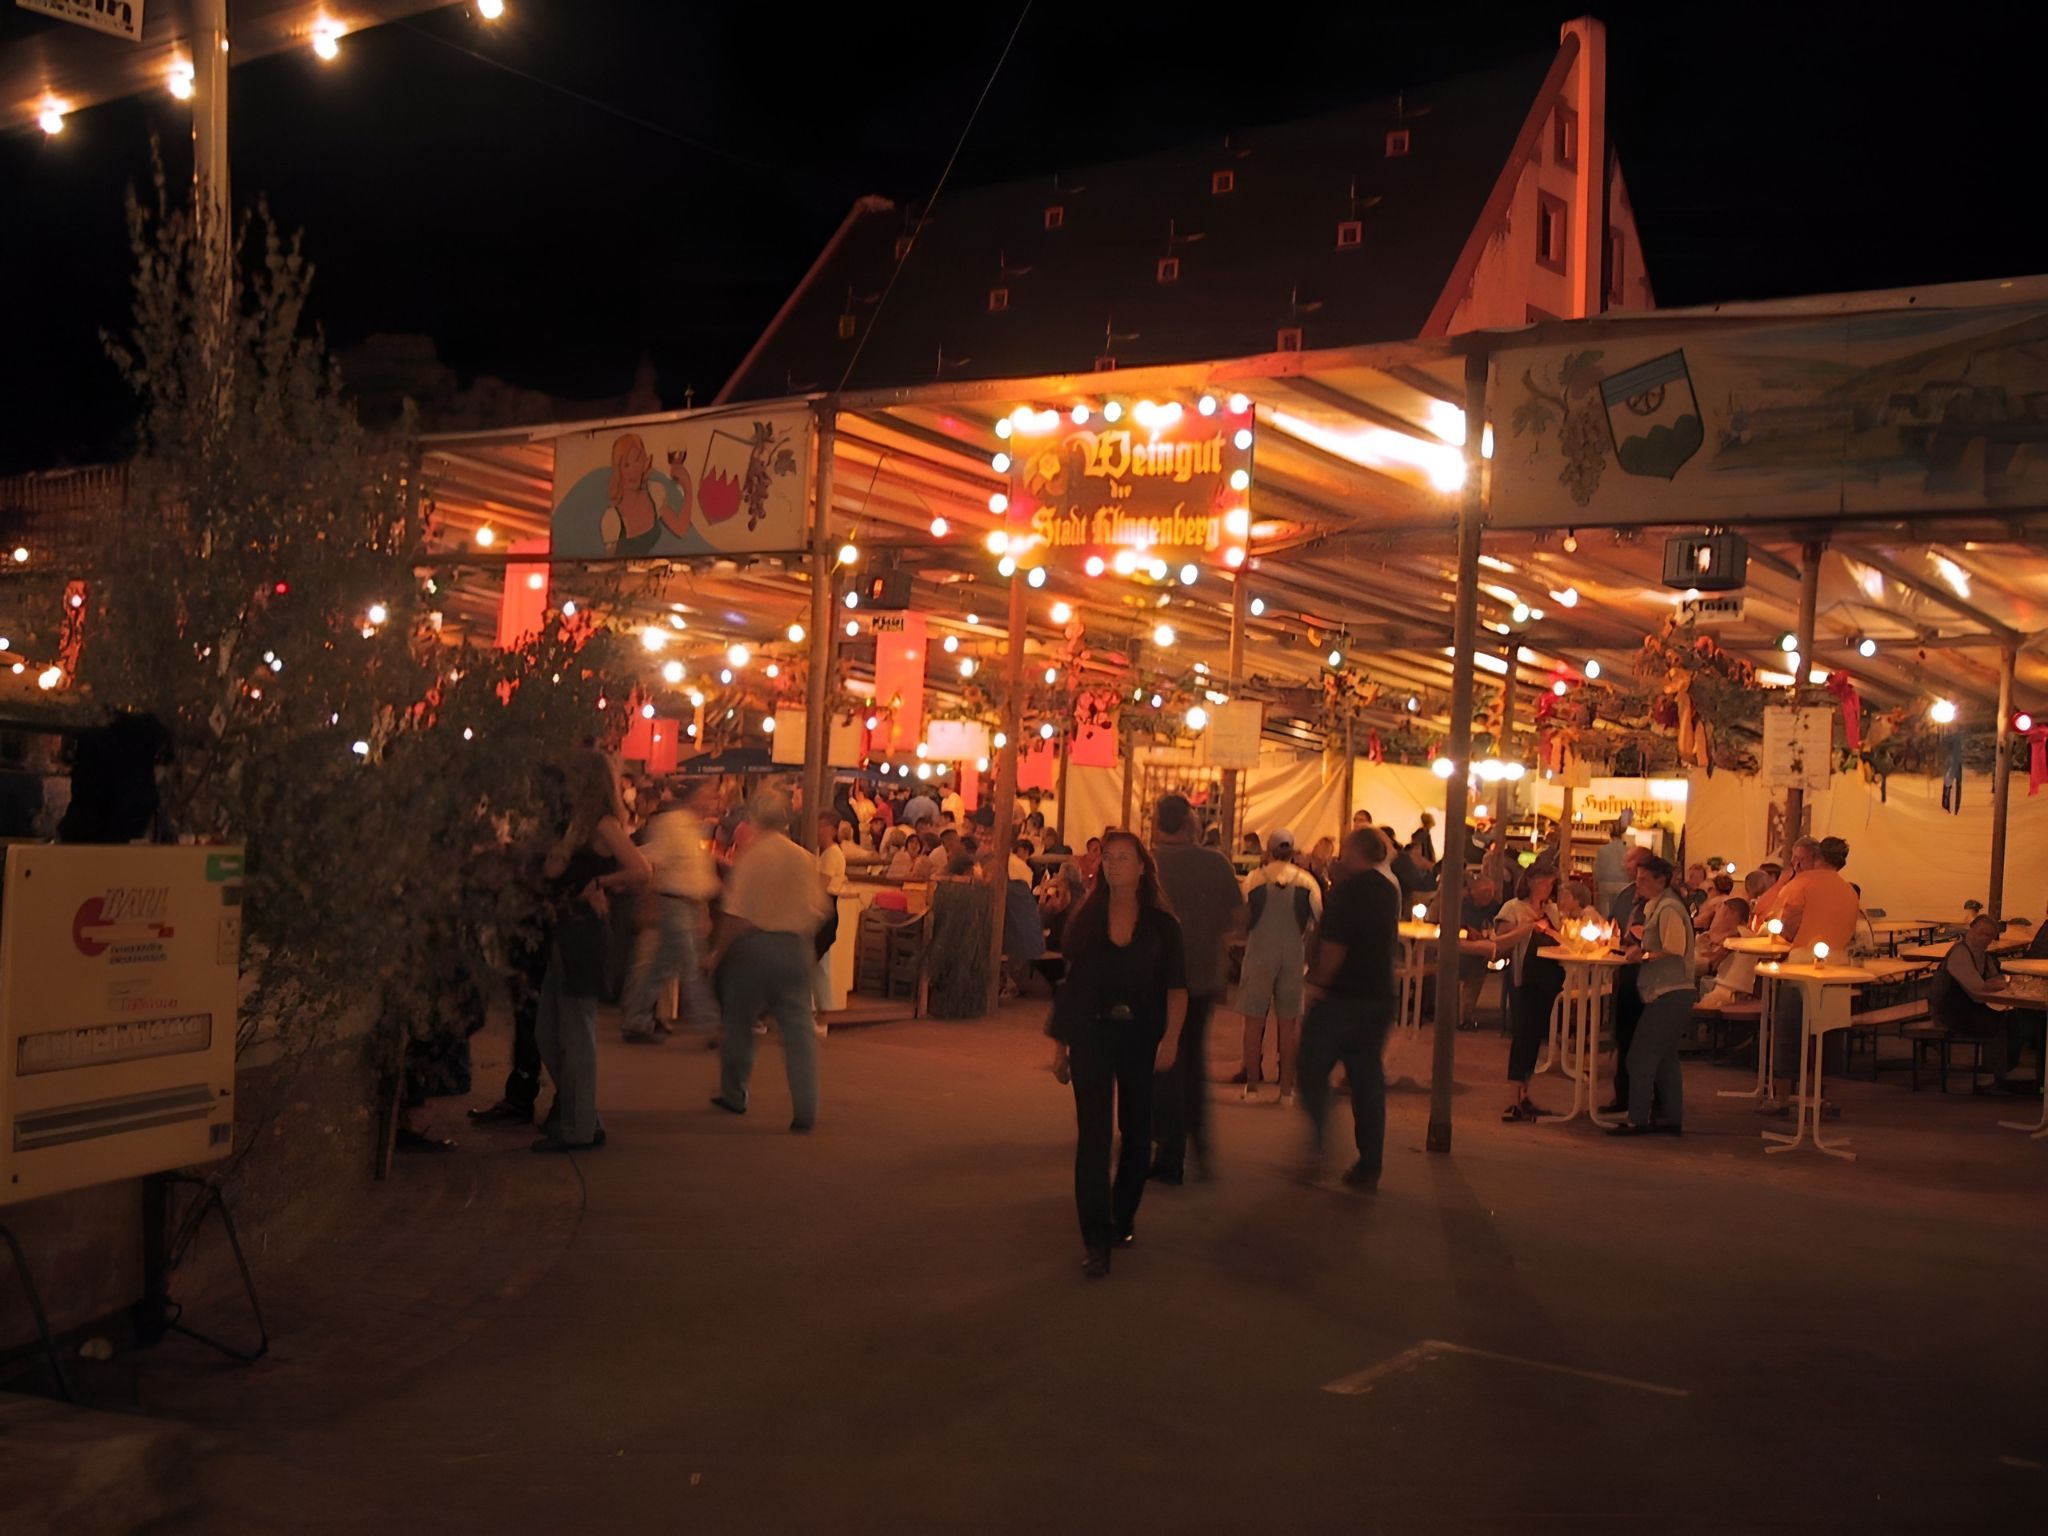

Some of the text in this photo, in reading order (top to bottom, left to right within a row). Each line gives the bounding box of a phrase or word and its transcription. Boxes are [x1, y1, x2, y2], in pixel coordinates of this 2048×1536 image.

[1063, 430, 1226, 482] Weingut
[1031, 501, 1220, 552] Stadt Klingenberg
